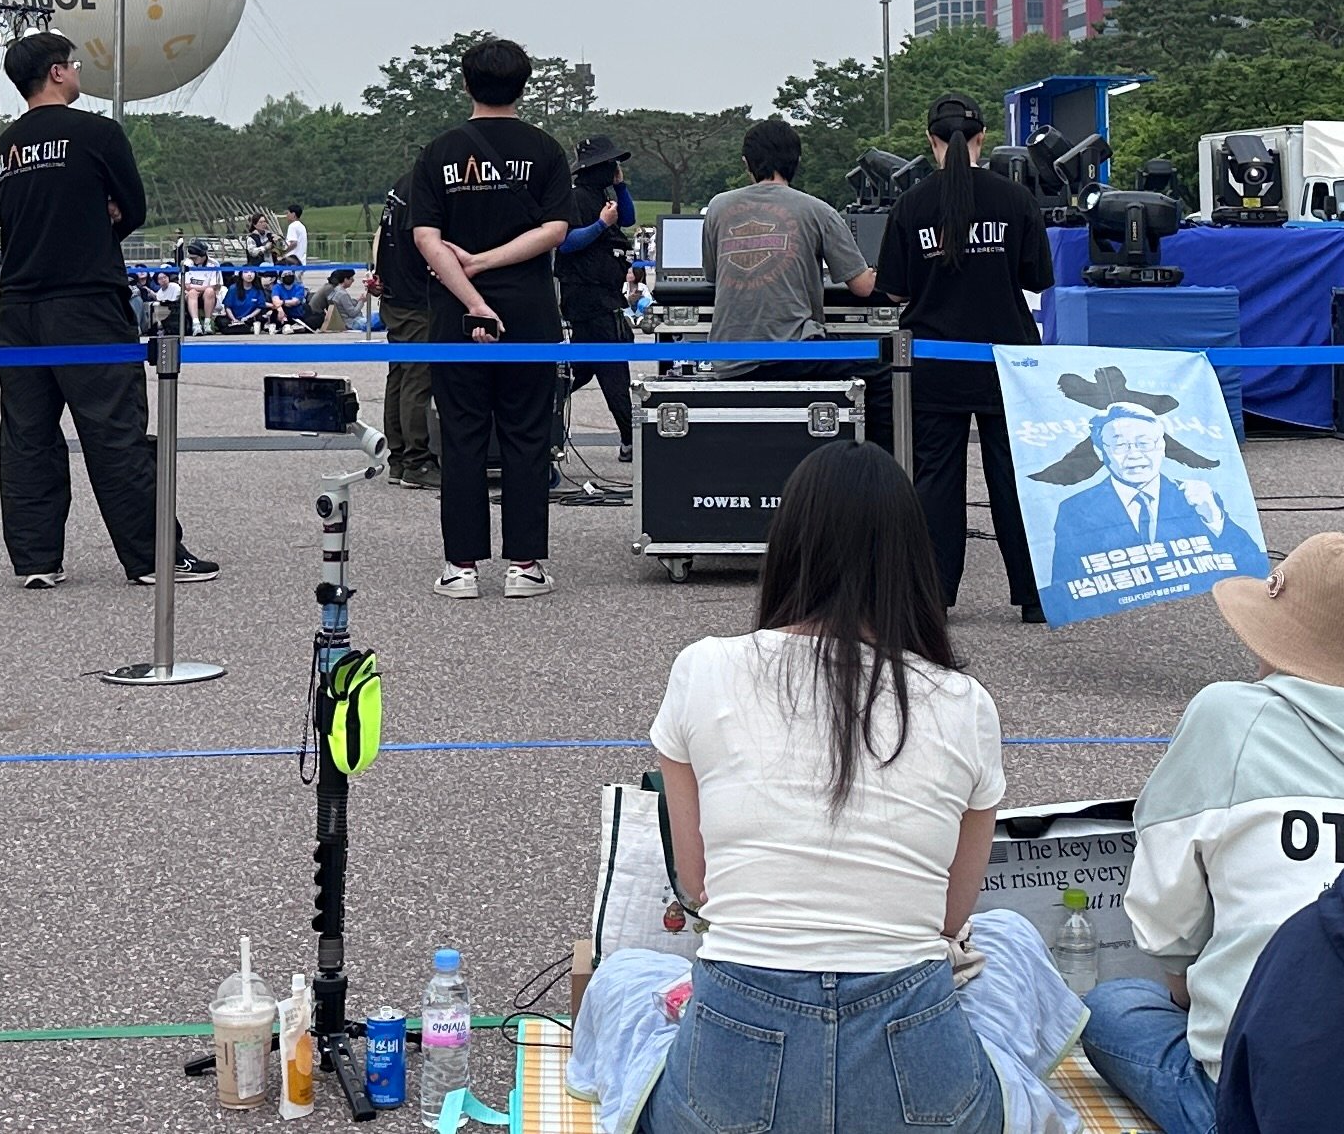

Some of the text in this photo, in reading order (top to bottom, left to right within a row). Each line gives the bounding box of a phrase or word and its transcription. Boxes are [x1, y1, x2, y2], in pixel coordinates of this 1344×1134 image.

[43, 139, 70, 160] OUT
[983, 221, 1009, 243] OUT
[693, 497, 751, 508] POWER
[1011, 833, 1136, 861] The key to S
[980, 866, 1128, 891] ust rising every
[1109, 893, 1124, 909] n
